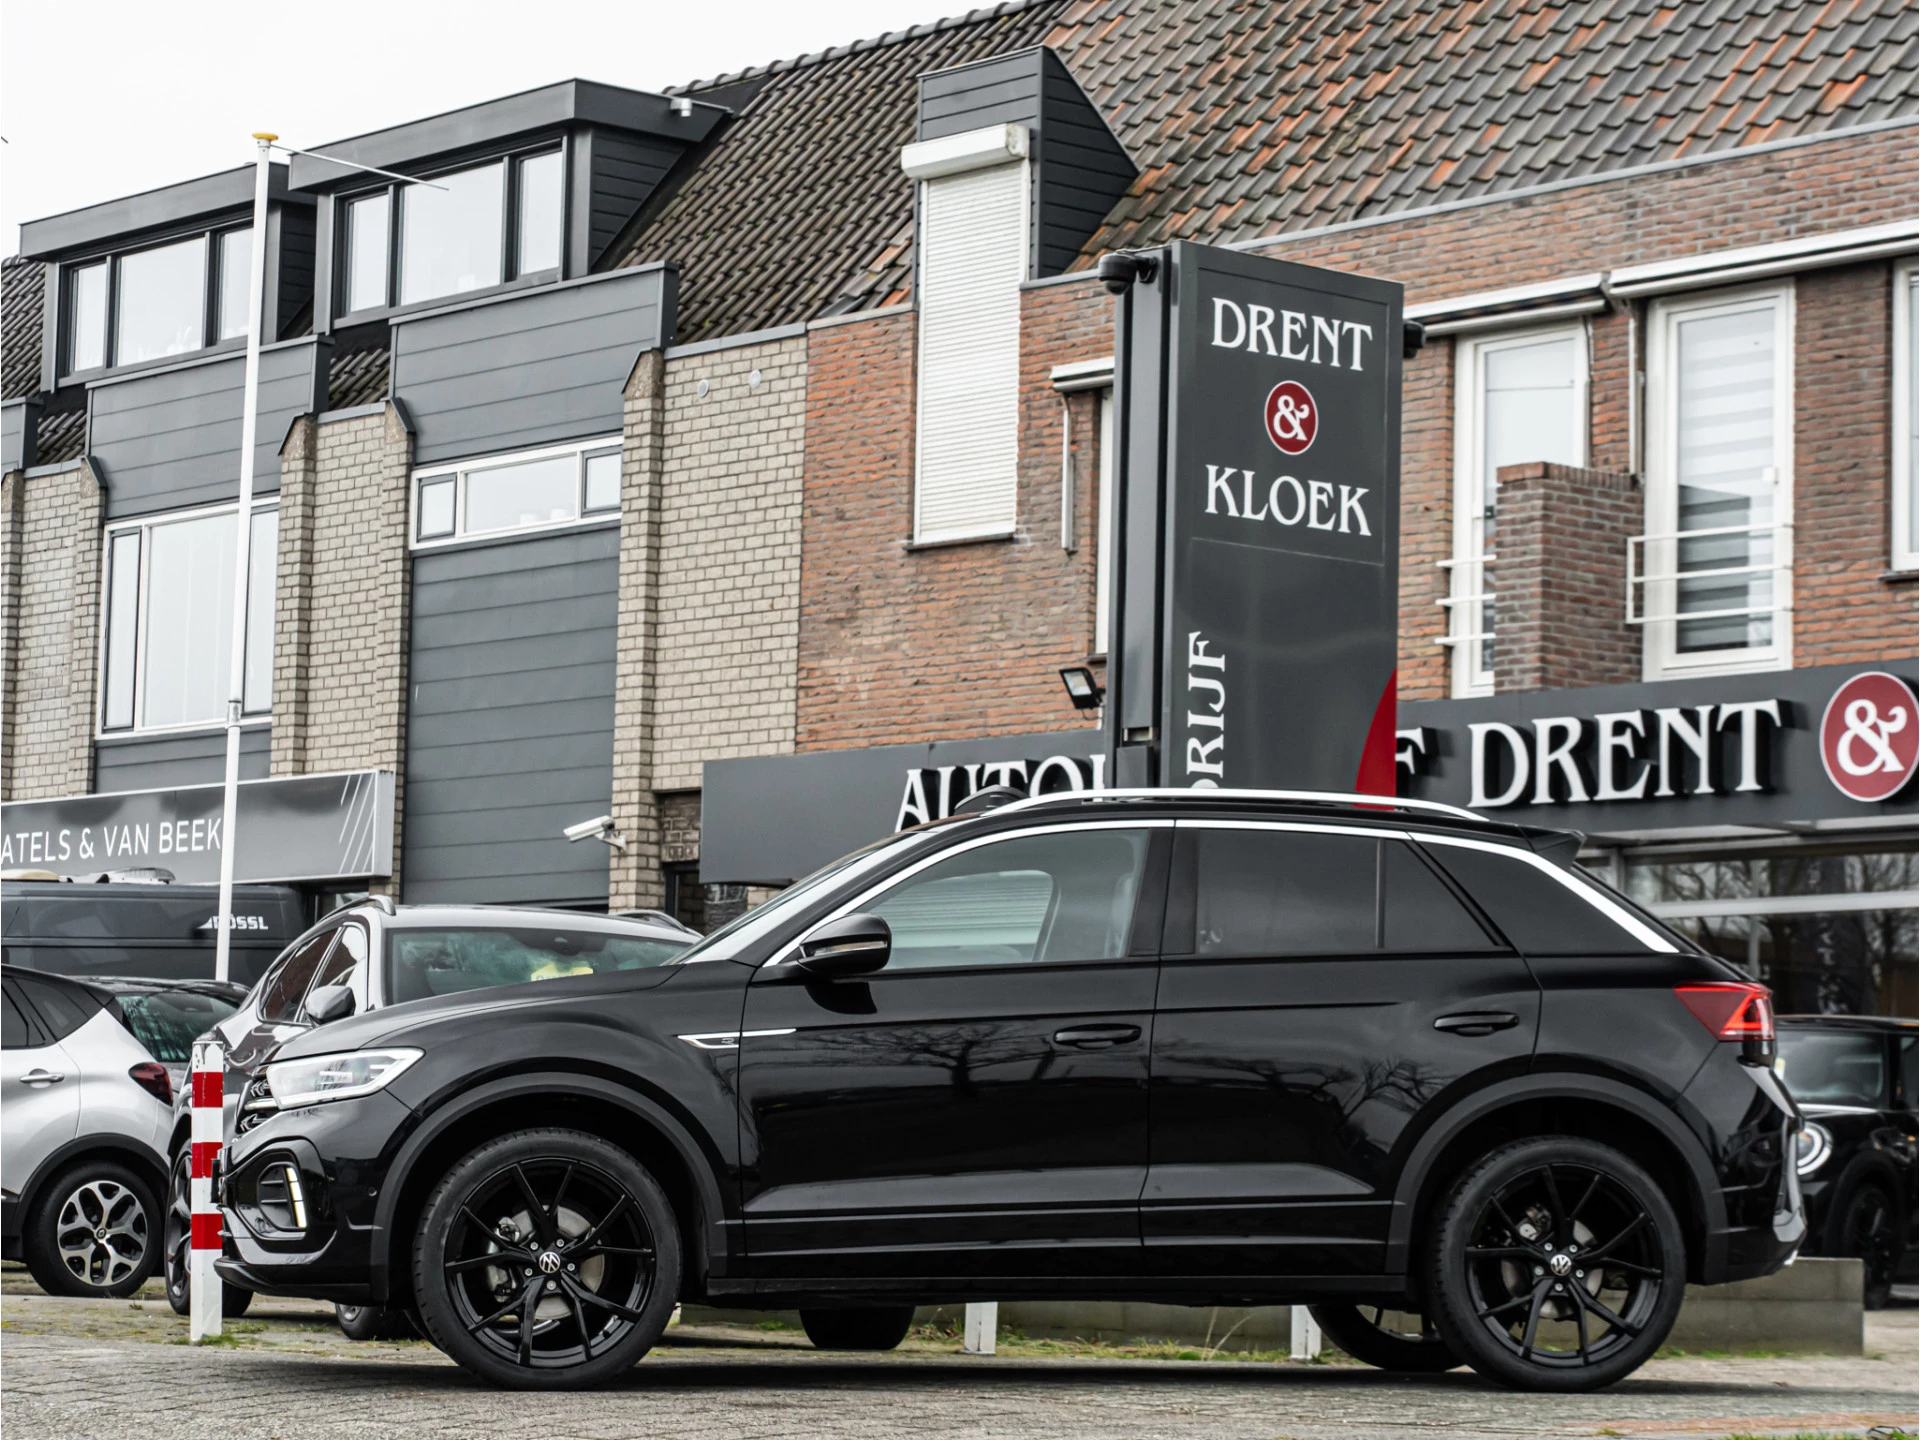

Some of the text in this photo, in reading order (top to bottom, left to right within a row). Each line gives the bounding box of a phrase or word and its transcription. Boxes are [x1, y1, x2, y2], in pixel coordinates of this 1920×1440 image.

[1211, 297, 1373, 371] DRENT
[1273, 395, 1310, 441] &
[1204, 464, 1372, 537] KLOEK
[1186, 631, 1226, 788] RIJF
[895, 754, 1106, 833] AUTO
[1467, 699, 1782, 808] DRENT
[1837, 699, 1908, 776] &
[79, 828, 94, 859] &
[104, 823, 149, 857] VAN
[159, 818, 222, 854] BEEK
